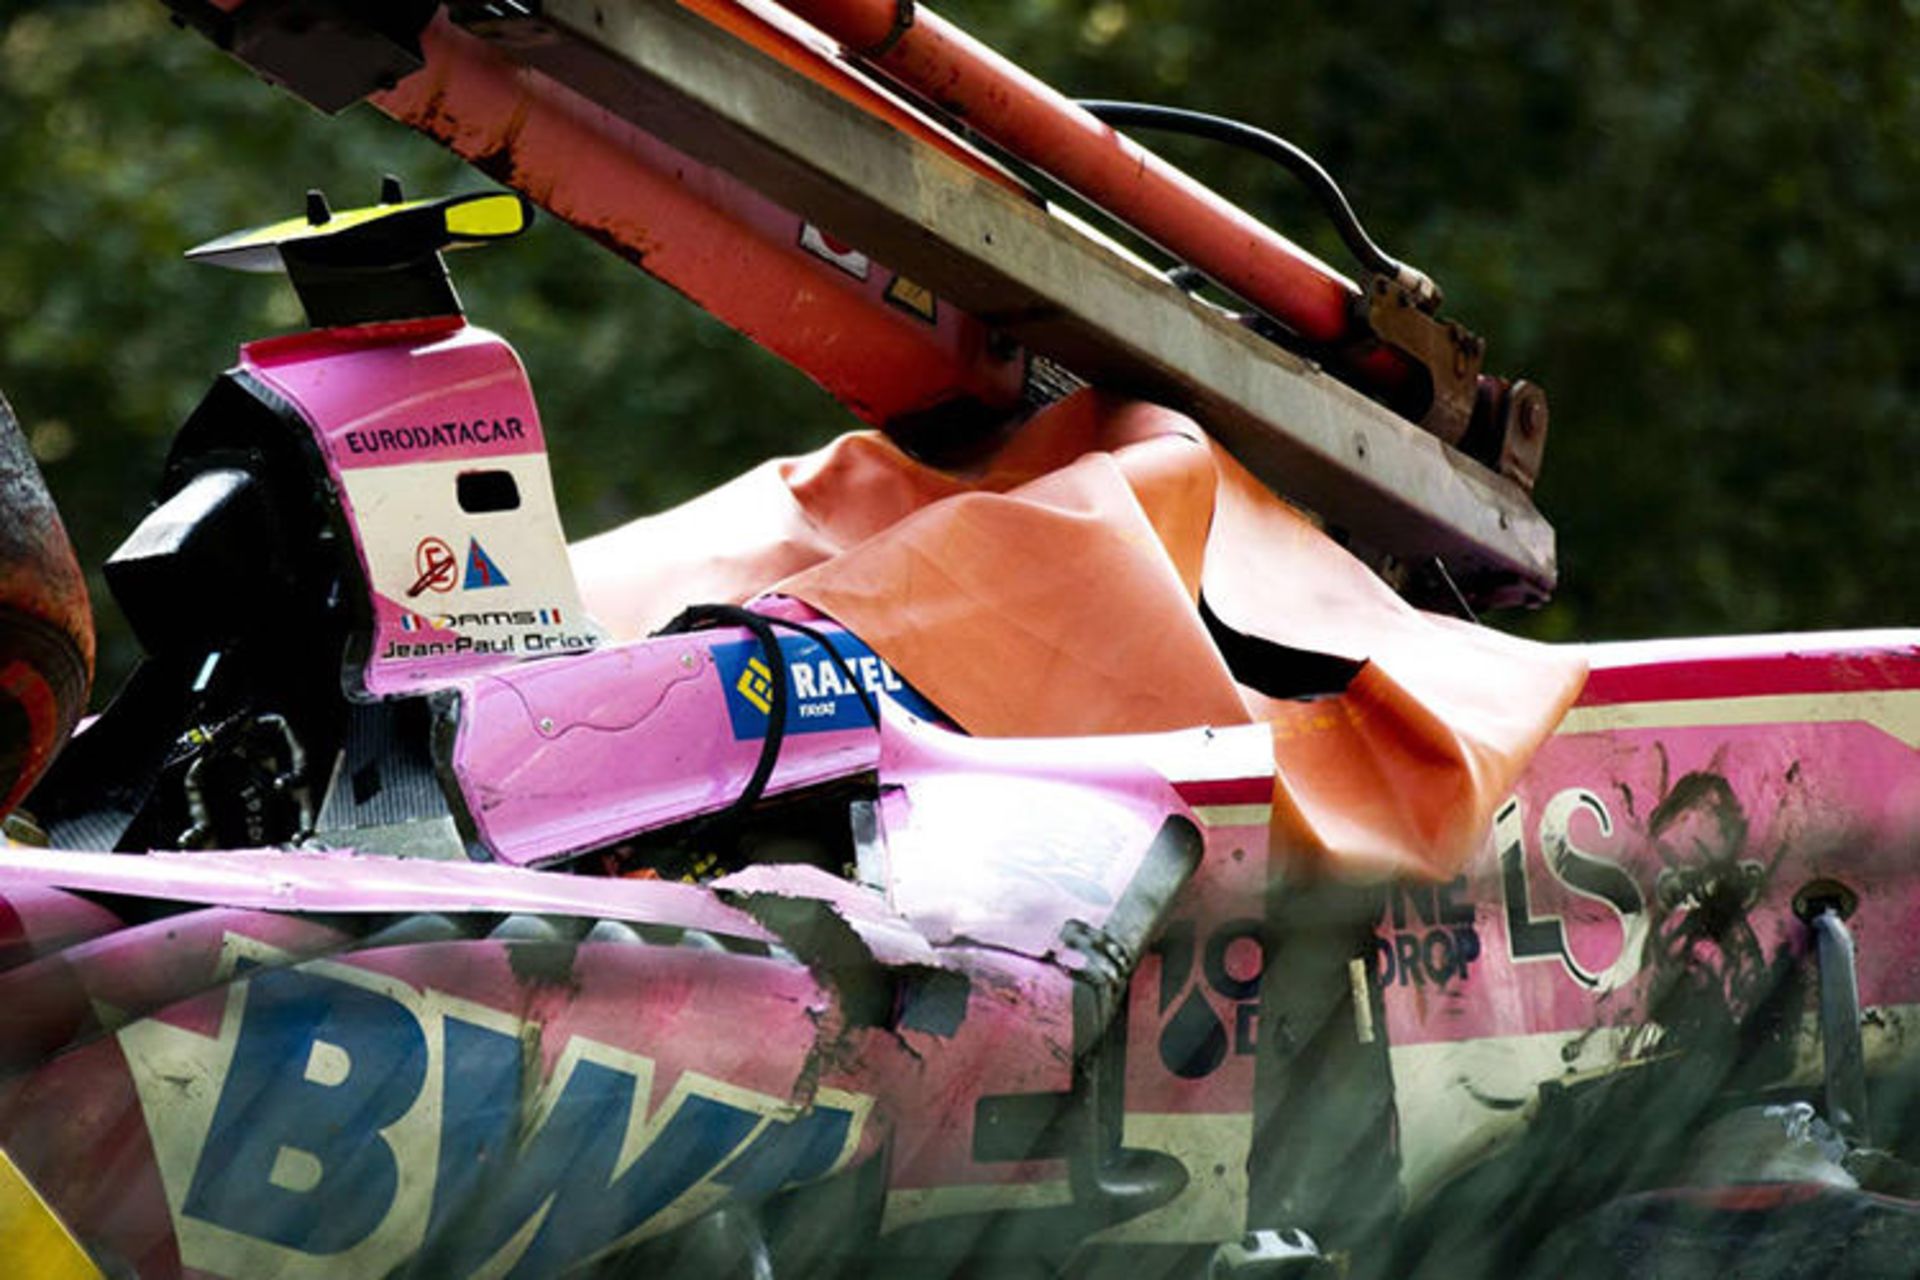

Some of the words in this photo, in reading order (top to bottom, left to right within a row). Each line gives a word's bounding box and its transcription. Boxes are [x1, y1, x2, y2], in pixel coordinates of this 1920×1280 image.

[346, 417, 525, 453] EURODATACAR
[381, 634, 516, 658] Jean-Paul
[790, 656, 902, 699] RAZEL
